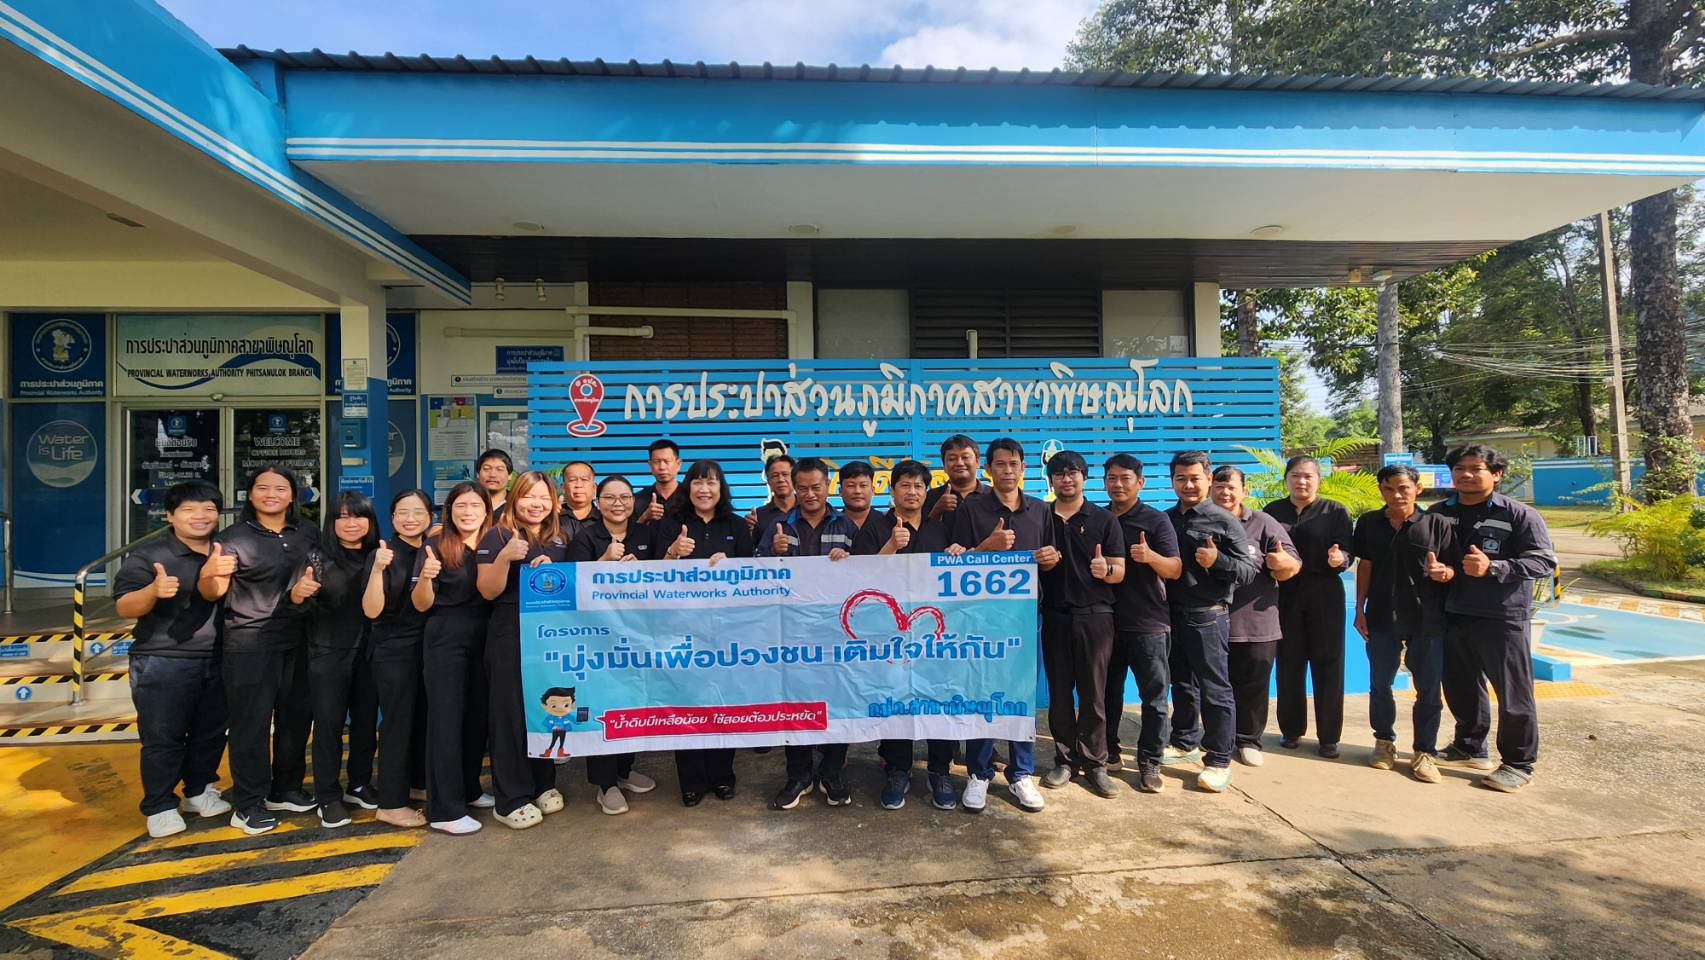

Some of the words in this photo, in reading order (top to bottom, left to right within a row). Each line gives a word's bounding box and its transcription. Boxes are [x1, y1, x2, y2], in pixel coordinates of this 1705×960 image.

[126, 333, 314, 359] การประปาส่วนภูมิภาคสาขาพิษณุโลก
[127, 369, 164, 378] PROVINCIAL
[166, 369, 209, 378] WATERWORKS
[210, 369, 243, 377] AUTHORITY
[245, 368, 286, 377] PHITSANULOK
[288, 368, 313, 377] BRANCH
[624, 358, 1193, 437] การประปาส่วนภูมิภาคสาขาพิษณุโลก
[38, 434, 89, 445] Water
[253, 436, 300, 447] WELCOME
[38, 445, 50, 456] is
[51, 445, 84, 460] Life
[937, 555, 964, 565] PWA
[966, 554, 989, 564] Call
[992, 554, 1031, 563] Center
[592, 565, 792, 585] การประปาส่วนภูมิภาค
[937, 568, 1031, 597] 1662
[592, 589, 648, 600] Provincial
[653, 587, 727, 599] Waterworks
[732, 585, 791, 597] Authority
[537, 624, 610, 639] โครงการ
